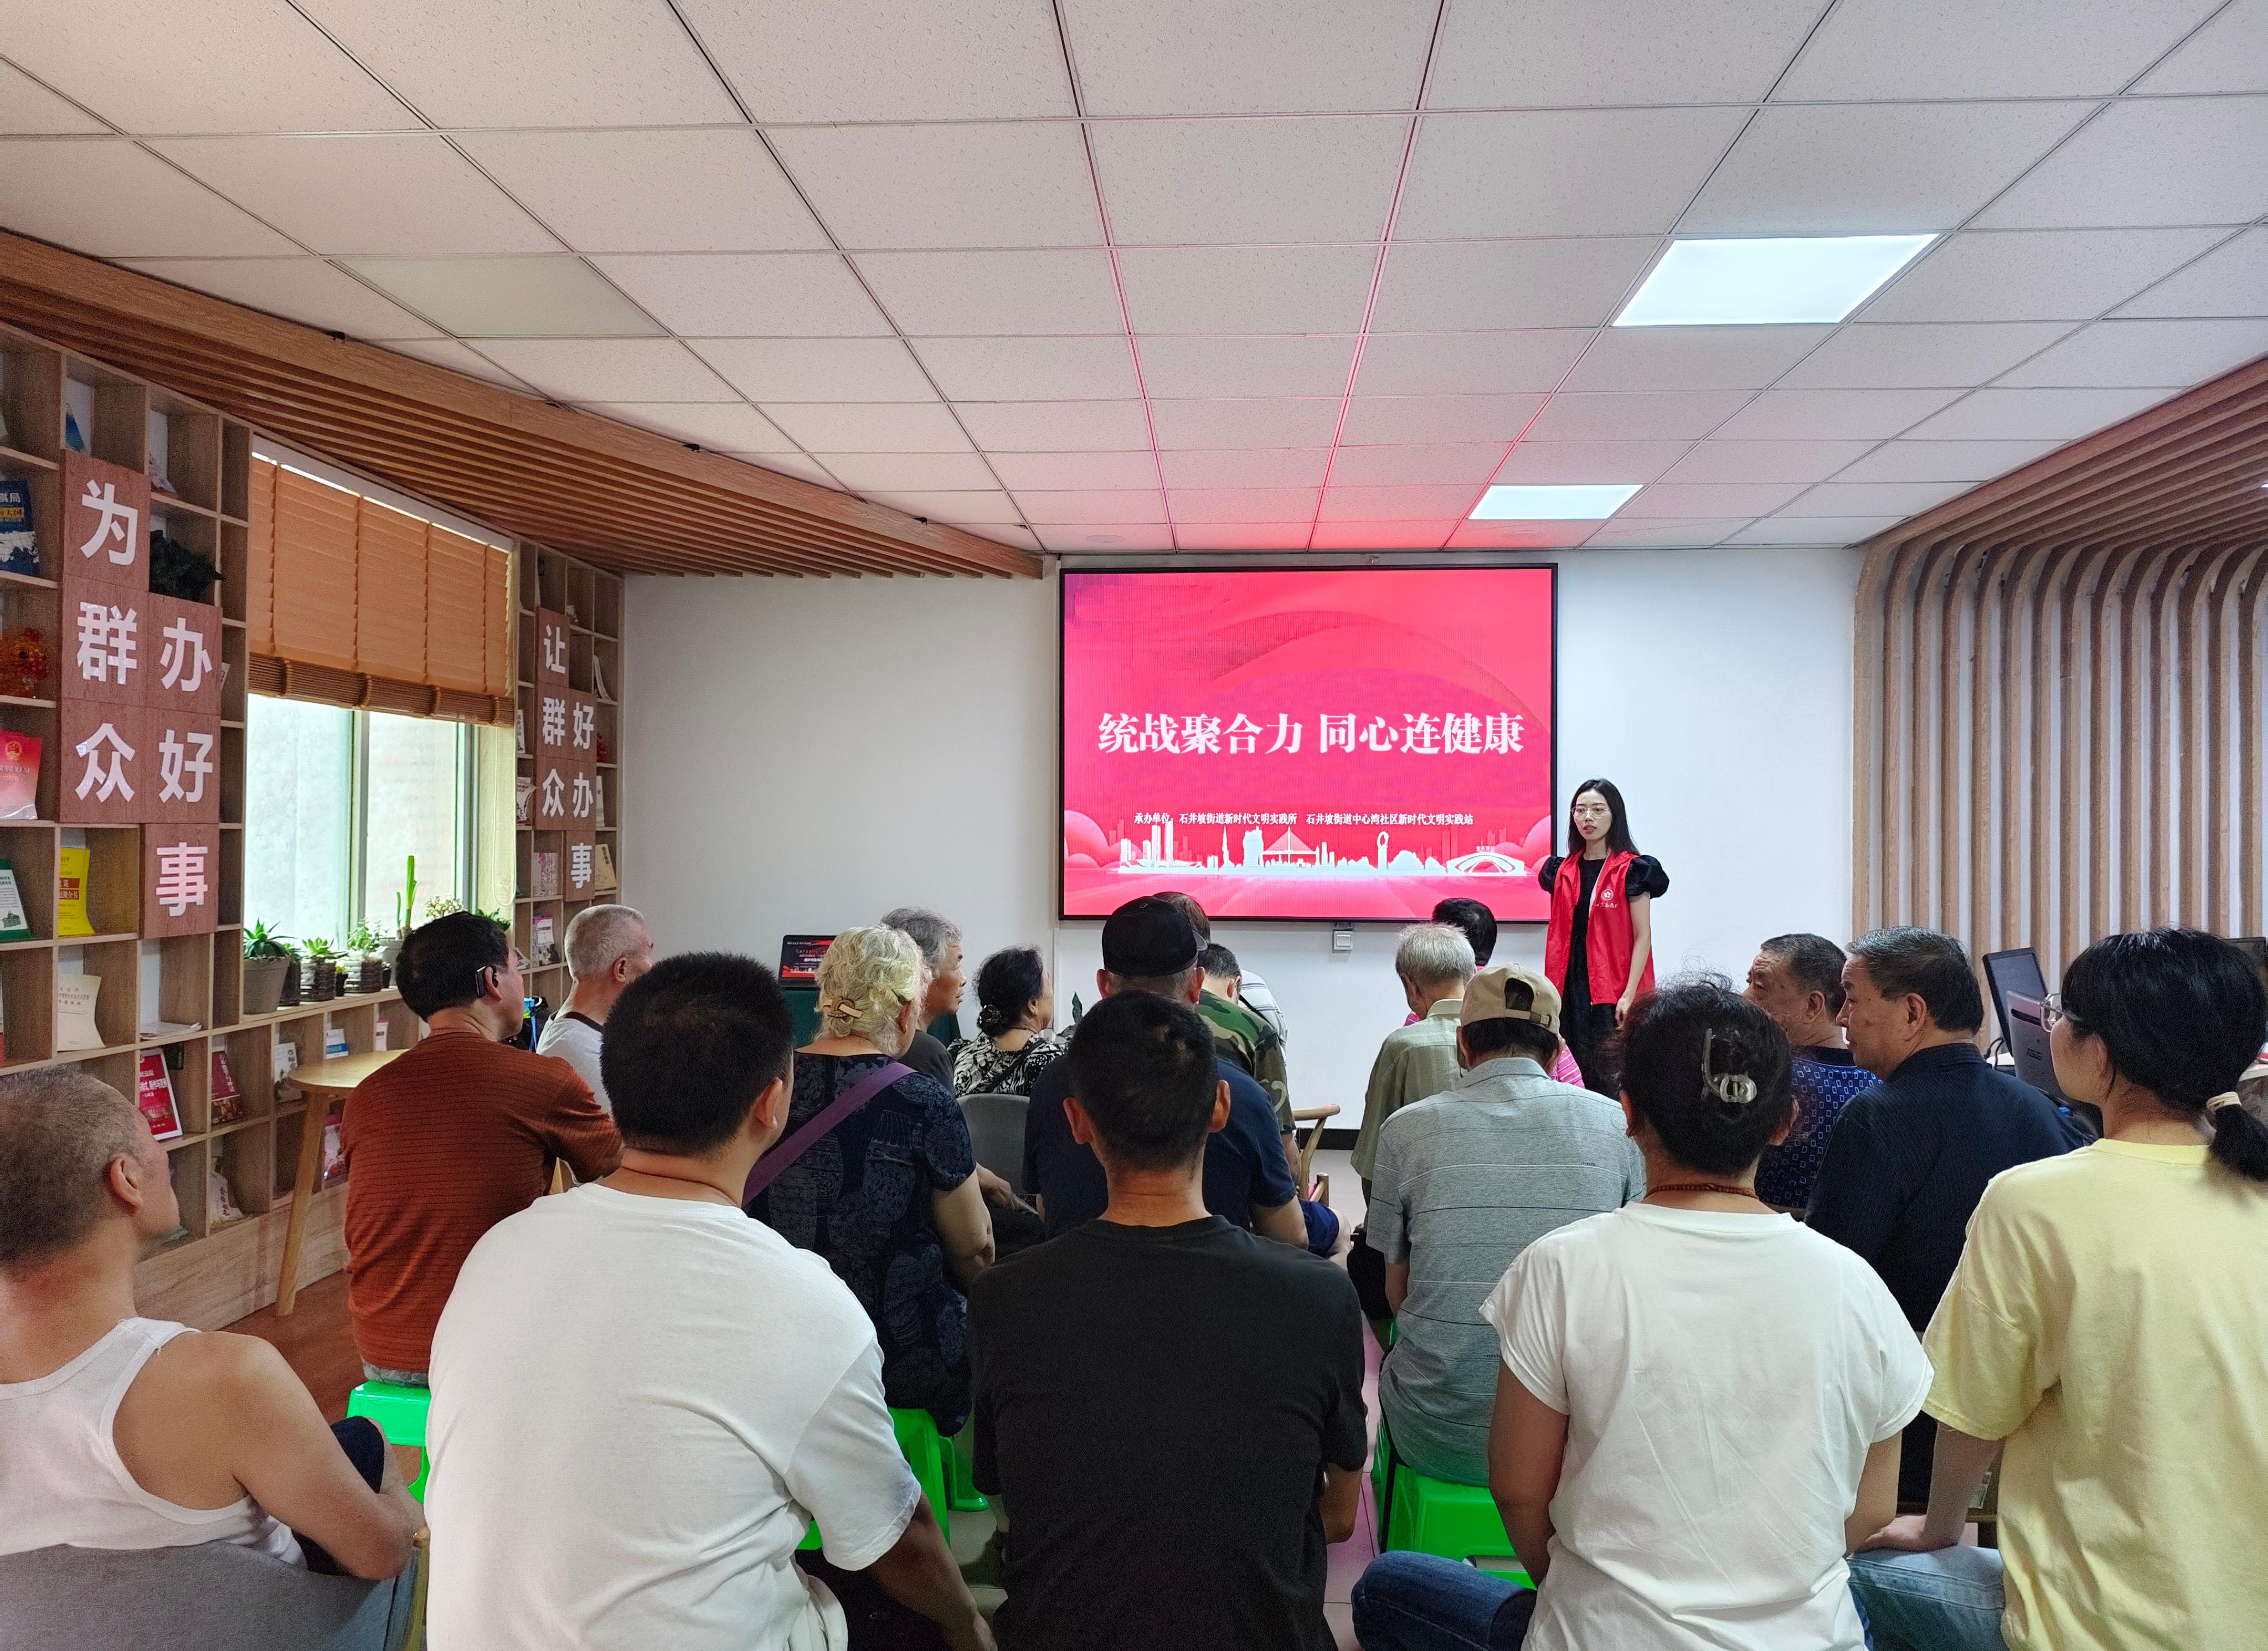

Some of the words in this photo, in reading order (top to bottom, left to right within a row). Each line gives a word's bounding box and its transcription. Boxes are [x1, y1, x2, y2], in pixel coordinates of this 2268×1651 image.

[75, 479, 138, 803] 为群众
[542, 624, 566, 817] 让群众
[1098, 713, 1303, 754] 统战聚合力
[1319, 712, 1525, 754] 同心连健康
[157, 617, 214, 917] 办好事
[571, 702, 594, 889] 好办事
[1179, 813, 1297, 825] 石井坡街道新时代文明实践所
[1306, 813, 1474, 826] 石井坡街道中心湾社区新时代文明实践站
